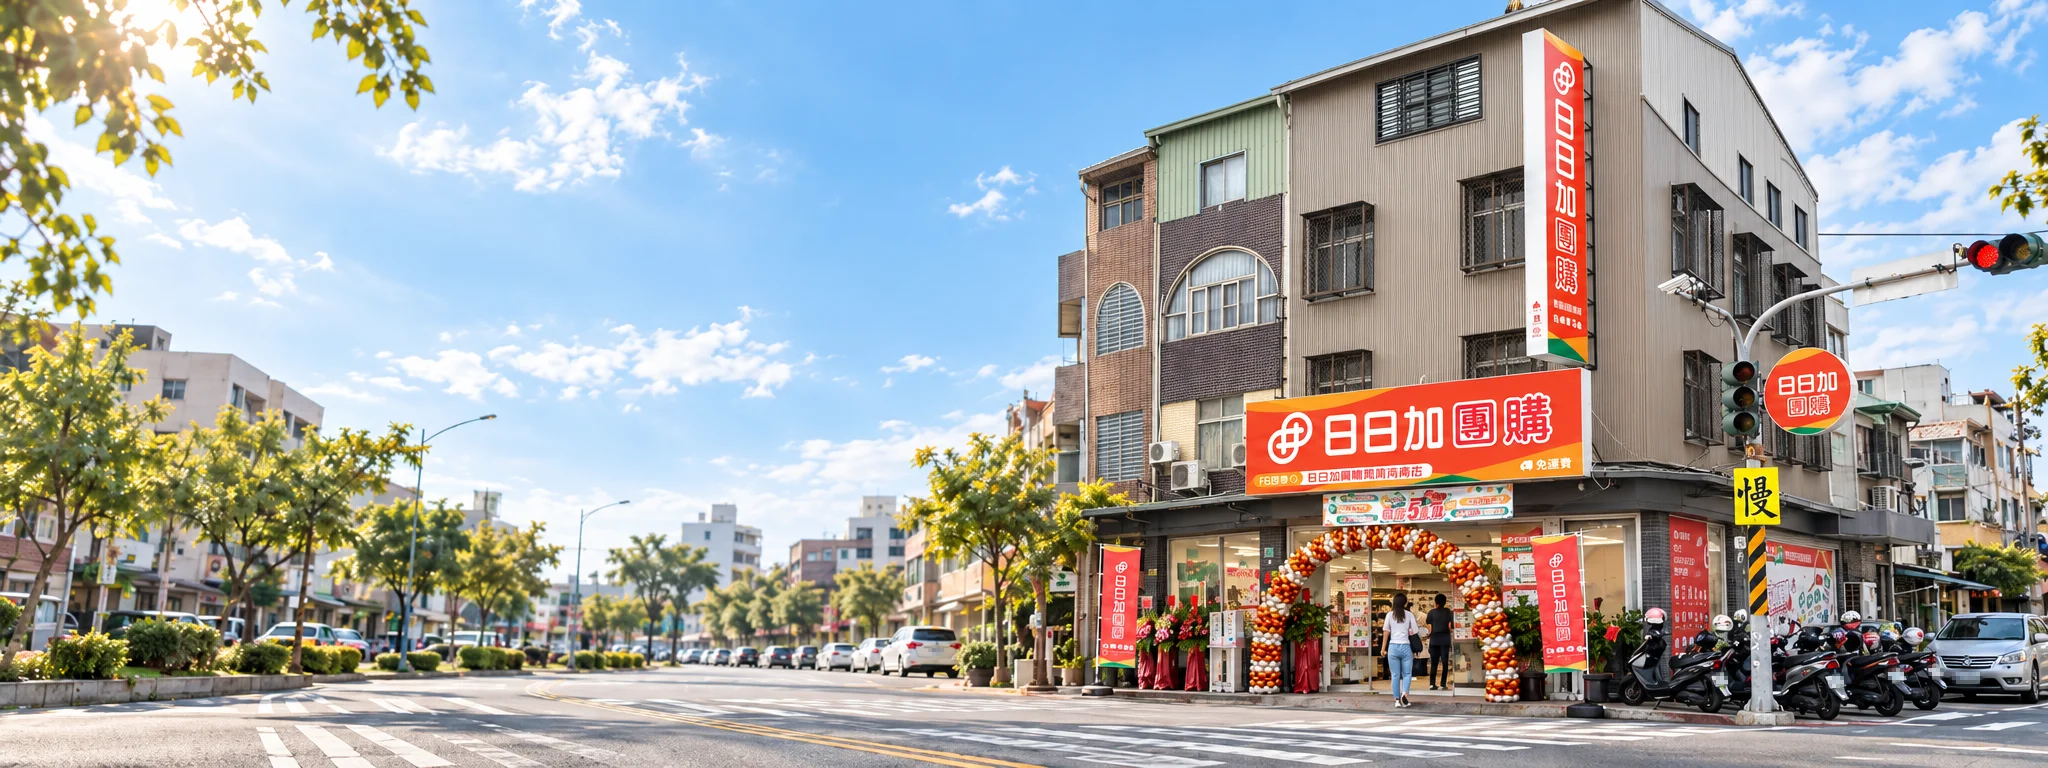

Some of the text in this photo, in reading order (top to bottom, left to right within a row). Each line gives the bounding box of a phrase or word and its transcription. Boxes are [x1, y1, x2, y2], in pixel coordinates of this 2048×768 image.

[1555, 98, 1578, 295] 日日加團購
[1778, 371, 1838, 396] 日日加
[1325, 392, 1553, 457] 日日加團購
[1536, 457, 1572, 471] 免運費
[1737, 475, 1778, 518] 慢
